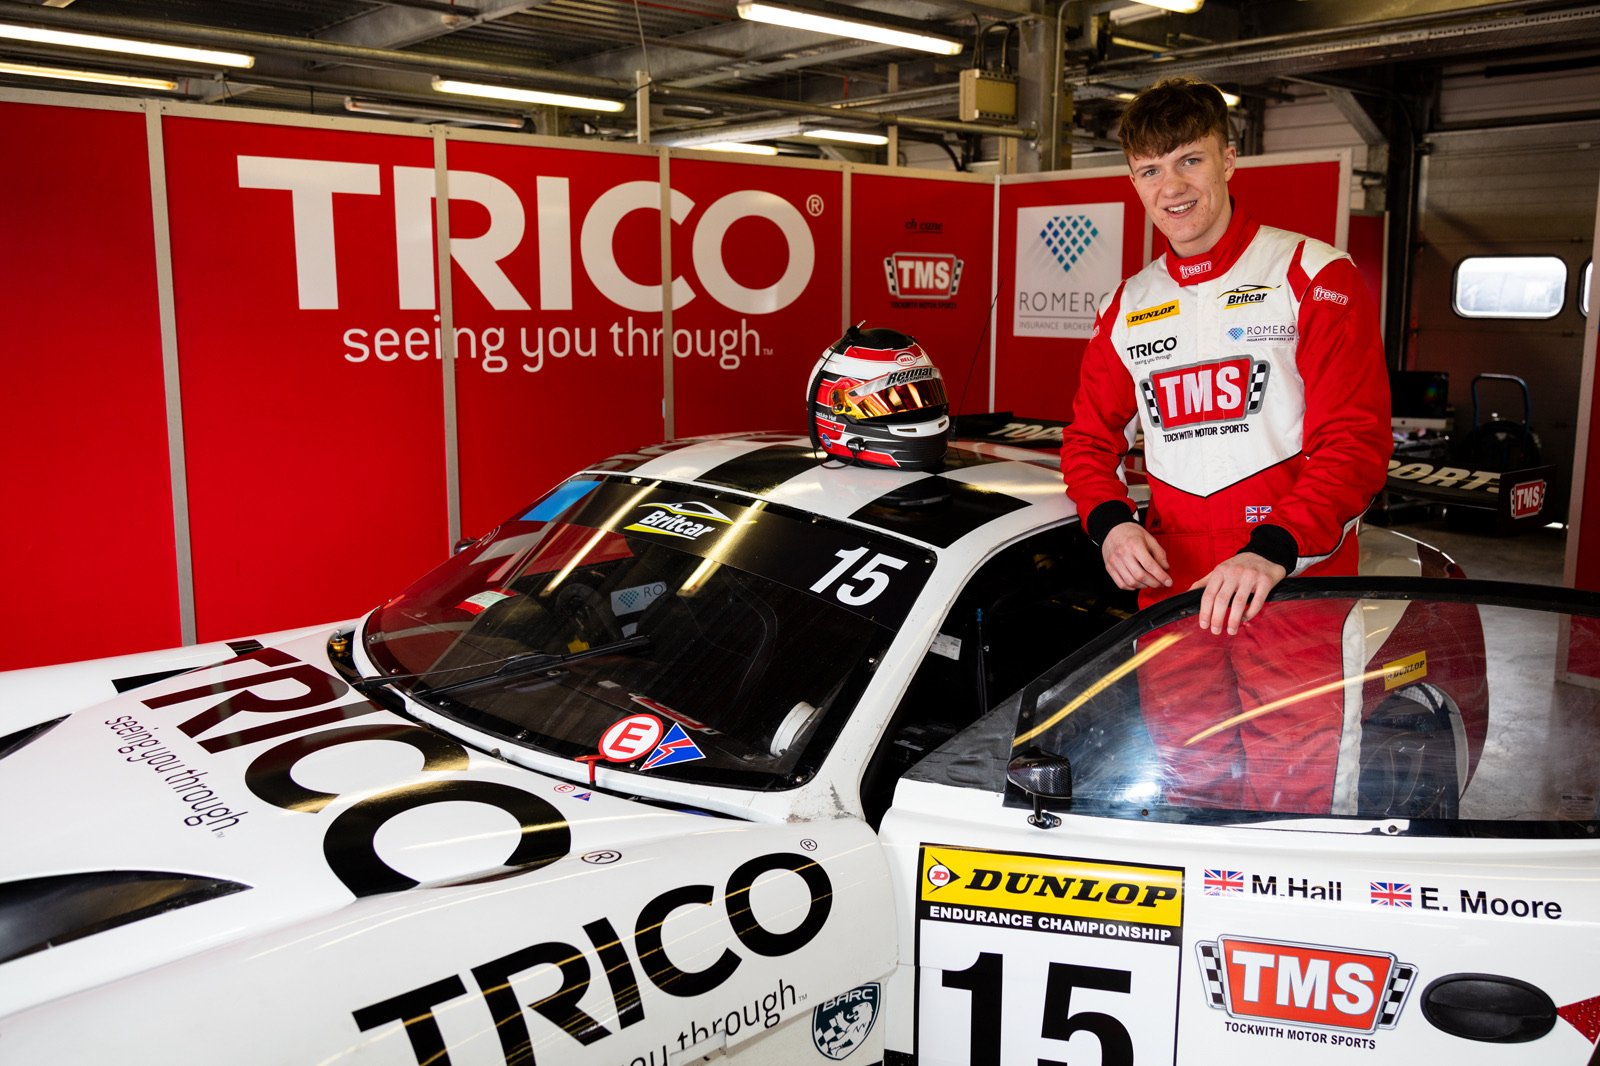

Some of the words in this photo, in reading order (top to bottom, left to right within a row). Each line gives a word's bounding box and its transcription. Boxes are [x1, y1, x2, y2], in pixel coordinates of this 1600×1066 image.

[237, 154, 816, 315] TRICO
[898, 261, 950, 290] TMS
[1227, 293, 1268, 305] Britcar
[1314, 286, 1348, 305] freem
[1130, 305, 1175, 322] DUNLOP
[1247, 325, 1296, 335] ROMERO
[343, 314, 508, 373] seeing
[520, 327, 597, 373] you
[1127, 337, 1177, 360] TRICO
[1159, 366, 1242, 419] TMS
[1195, 427, 1218, 438] MOTOR
[1220, 423, 1249, 435] SPORTS
[1516, 485, 1540, 511] TMS
[640, 510, 715, 538] Britcar
[808, 546, 909, 607] 15
[104, 715, 160, 754] seeing
[126, 746, 186, 774] you
[165, 769, 249, 832] through
[965, 868, 1178, 908] DUNLOP
[1251, 874, 1342, 902] M.Hall
[1420, 887, 1449, 912] E.
[1460, 889, 1563, 920] Moore
[929, 905, 1033, 928] ENDURANCE
[1038, 916, 1172, 942] CHAMPIONSHIP
[352, 852, 833, 1066] TRICO
[1231, 950, 1375, 1016] TMS
[822, 988, 873, 1012] BARC
[941, 951, 1135, 1066] 15
[1225, 1021, 1284, 1039] TOCKWITH
[1287, 1029, 1328, 1044] MOTOR
[1331, 1034, 1376, 1050] SPORTS
